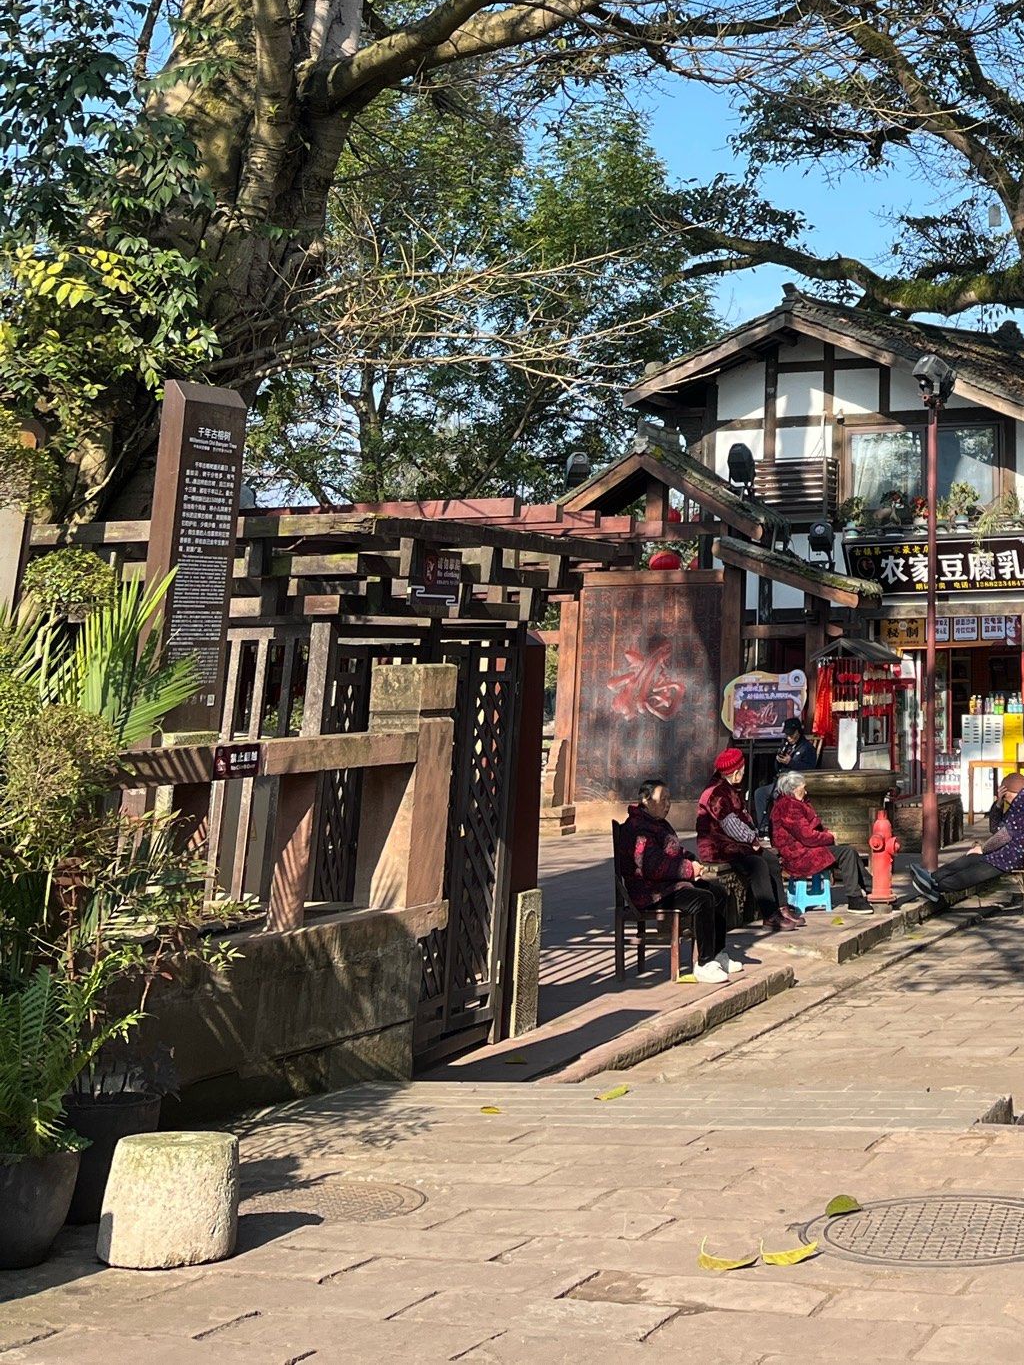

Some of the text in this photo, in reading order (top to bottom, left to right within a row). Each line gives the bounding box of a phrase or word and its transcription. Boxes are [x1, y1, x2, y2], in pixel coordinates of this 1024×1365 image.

[198, 427, 232, 442] 千年古榕树
